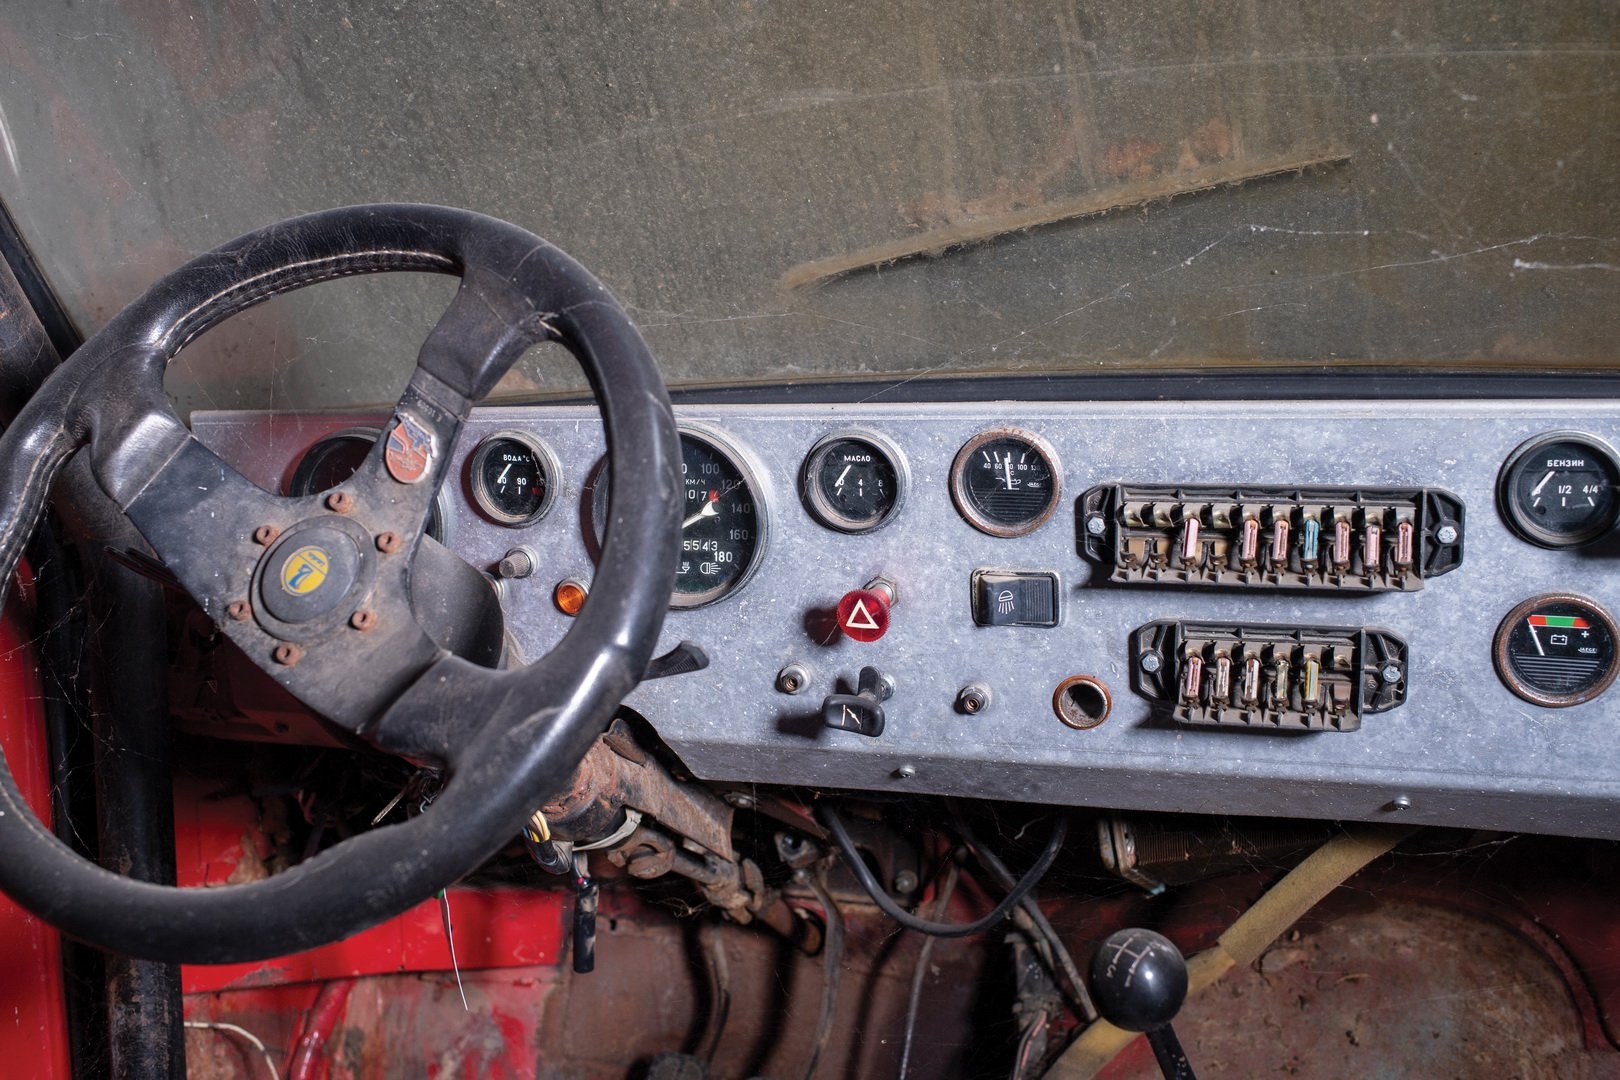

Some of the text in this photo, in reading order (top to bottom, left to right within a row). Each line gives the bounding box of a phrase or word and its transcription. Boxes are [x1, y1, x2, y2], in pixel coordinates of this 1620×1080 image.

[503, 454, 521, 462] ВОДА
[702, 463, 720, 474] 100
[517, 477, 527, 485] 90
[722, 480, 741, 490] 120
[1558, 485, 1572, 494] 1/2
[1582, 485, 1599, 494] 4/4
[732, 503, 750, 514] 140
[729, 529, 749, 540] 160
[713, 551, 733, 562] 180
